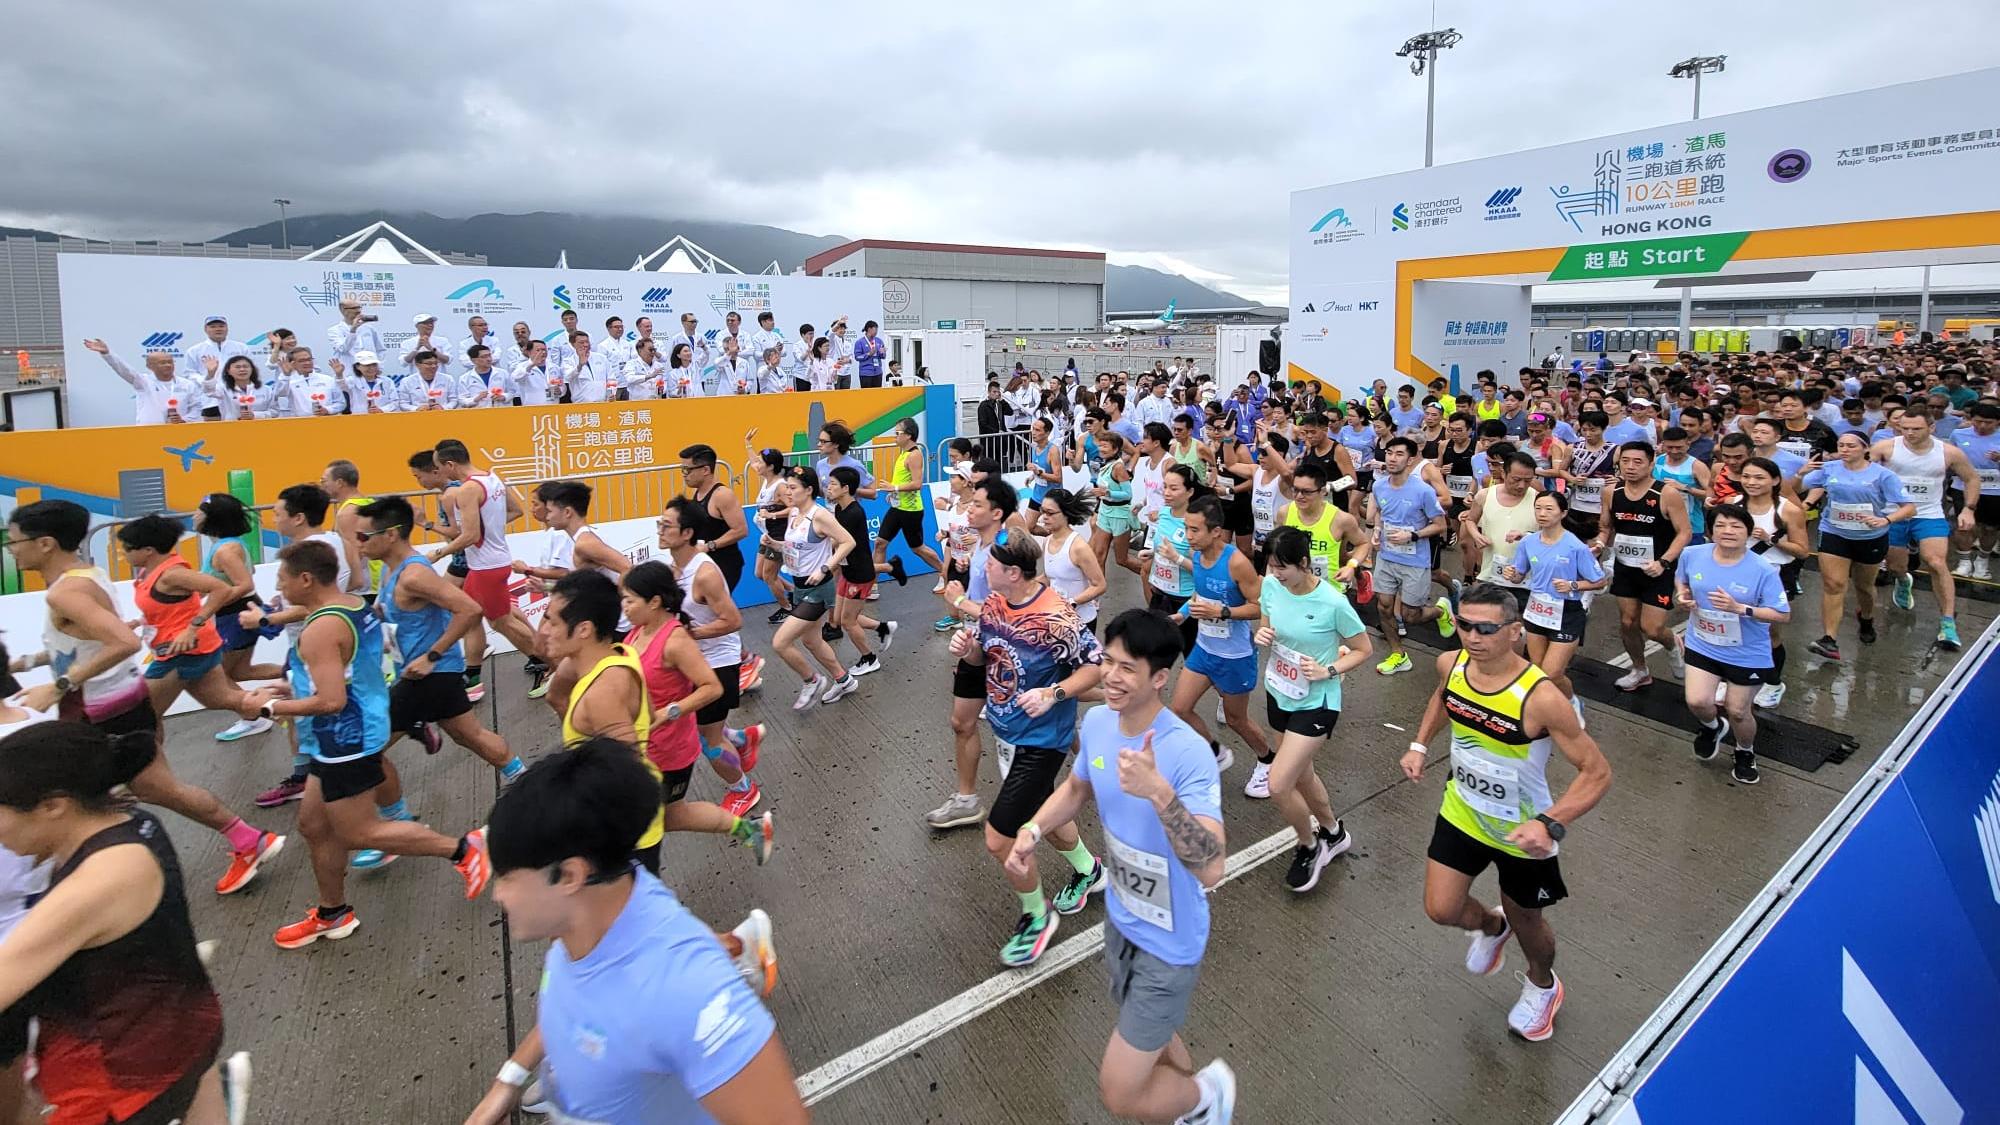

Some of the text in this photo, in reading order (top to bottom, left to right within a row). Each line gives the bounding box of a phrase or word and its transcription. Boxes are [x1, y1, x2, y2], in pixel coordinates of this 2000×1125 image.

[1868, 154, 1903, 164] Sports
[1906, 148, 1943, 158] Events
[1626, 152, 1726, 182] 三跑道系統
[1626, 174, 1725, 203] 10公里跑
[1414, 196, 1460, 211] standard
[1414, 204, 1462, 220] chartered
[1488, 206, 1517, 215] HKAAA
[1625, 195, 1725, 214] RUNWAY 10KM RACE
[1414, 216, 1449, 229] 渣打銀行
[1601, 215, 1712, 237] HONG KONG
[1584, 246, 1706, 270] 起點 Start
[576, 286, 620, 294] standard
[577, 293, 623, 301] chartered
[1359, 301, 1379, 311] HKT
[566, 428, 653, 448] 三跑道系統
[567, 446, 655, 470] 10公里跑
[1618, 545, 1647, 557] 2067
[1275, 659, 1298, 681] 850
[1456, 765, 1506, 800] 6029
